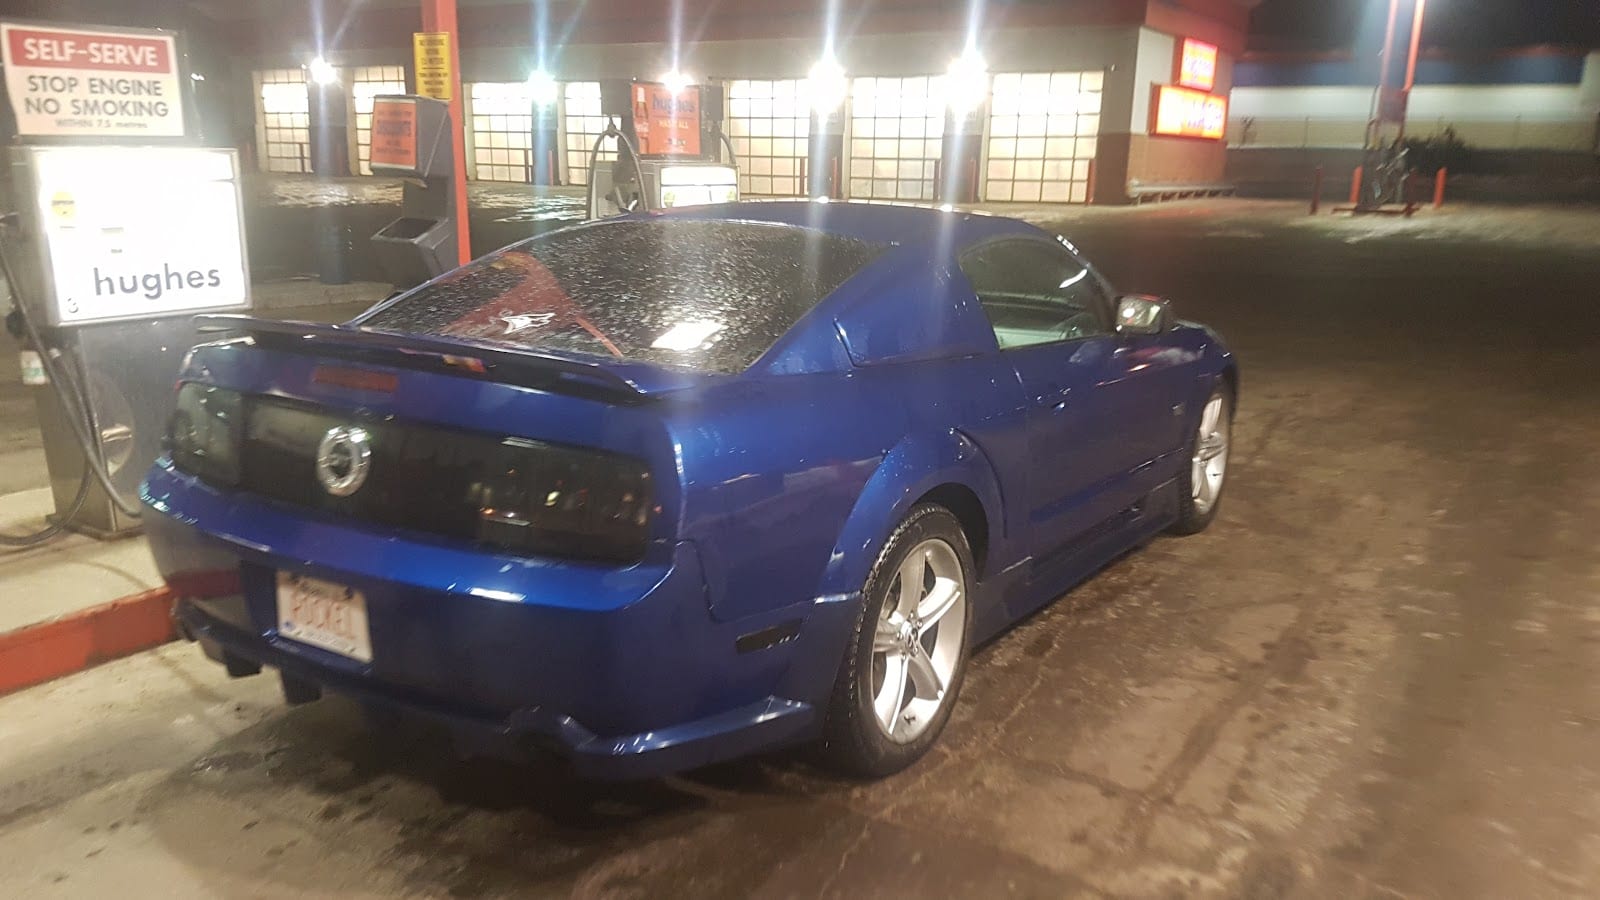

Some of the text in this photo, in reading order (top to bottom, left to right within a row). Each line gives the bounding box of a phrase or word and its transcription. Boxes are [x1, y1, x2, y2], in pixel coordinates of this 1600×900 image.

[23, 37, 158, 66] SELF-SERVE
[28, 74, 163, 97] STOP ENGINE
[24, 97, 169, 118] NO SMOKING
[93, 262, 221, 300] hughes
